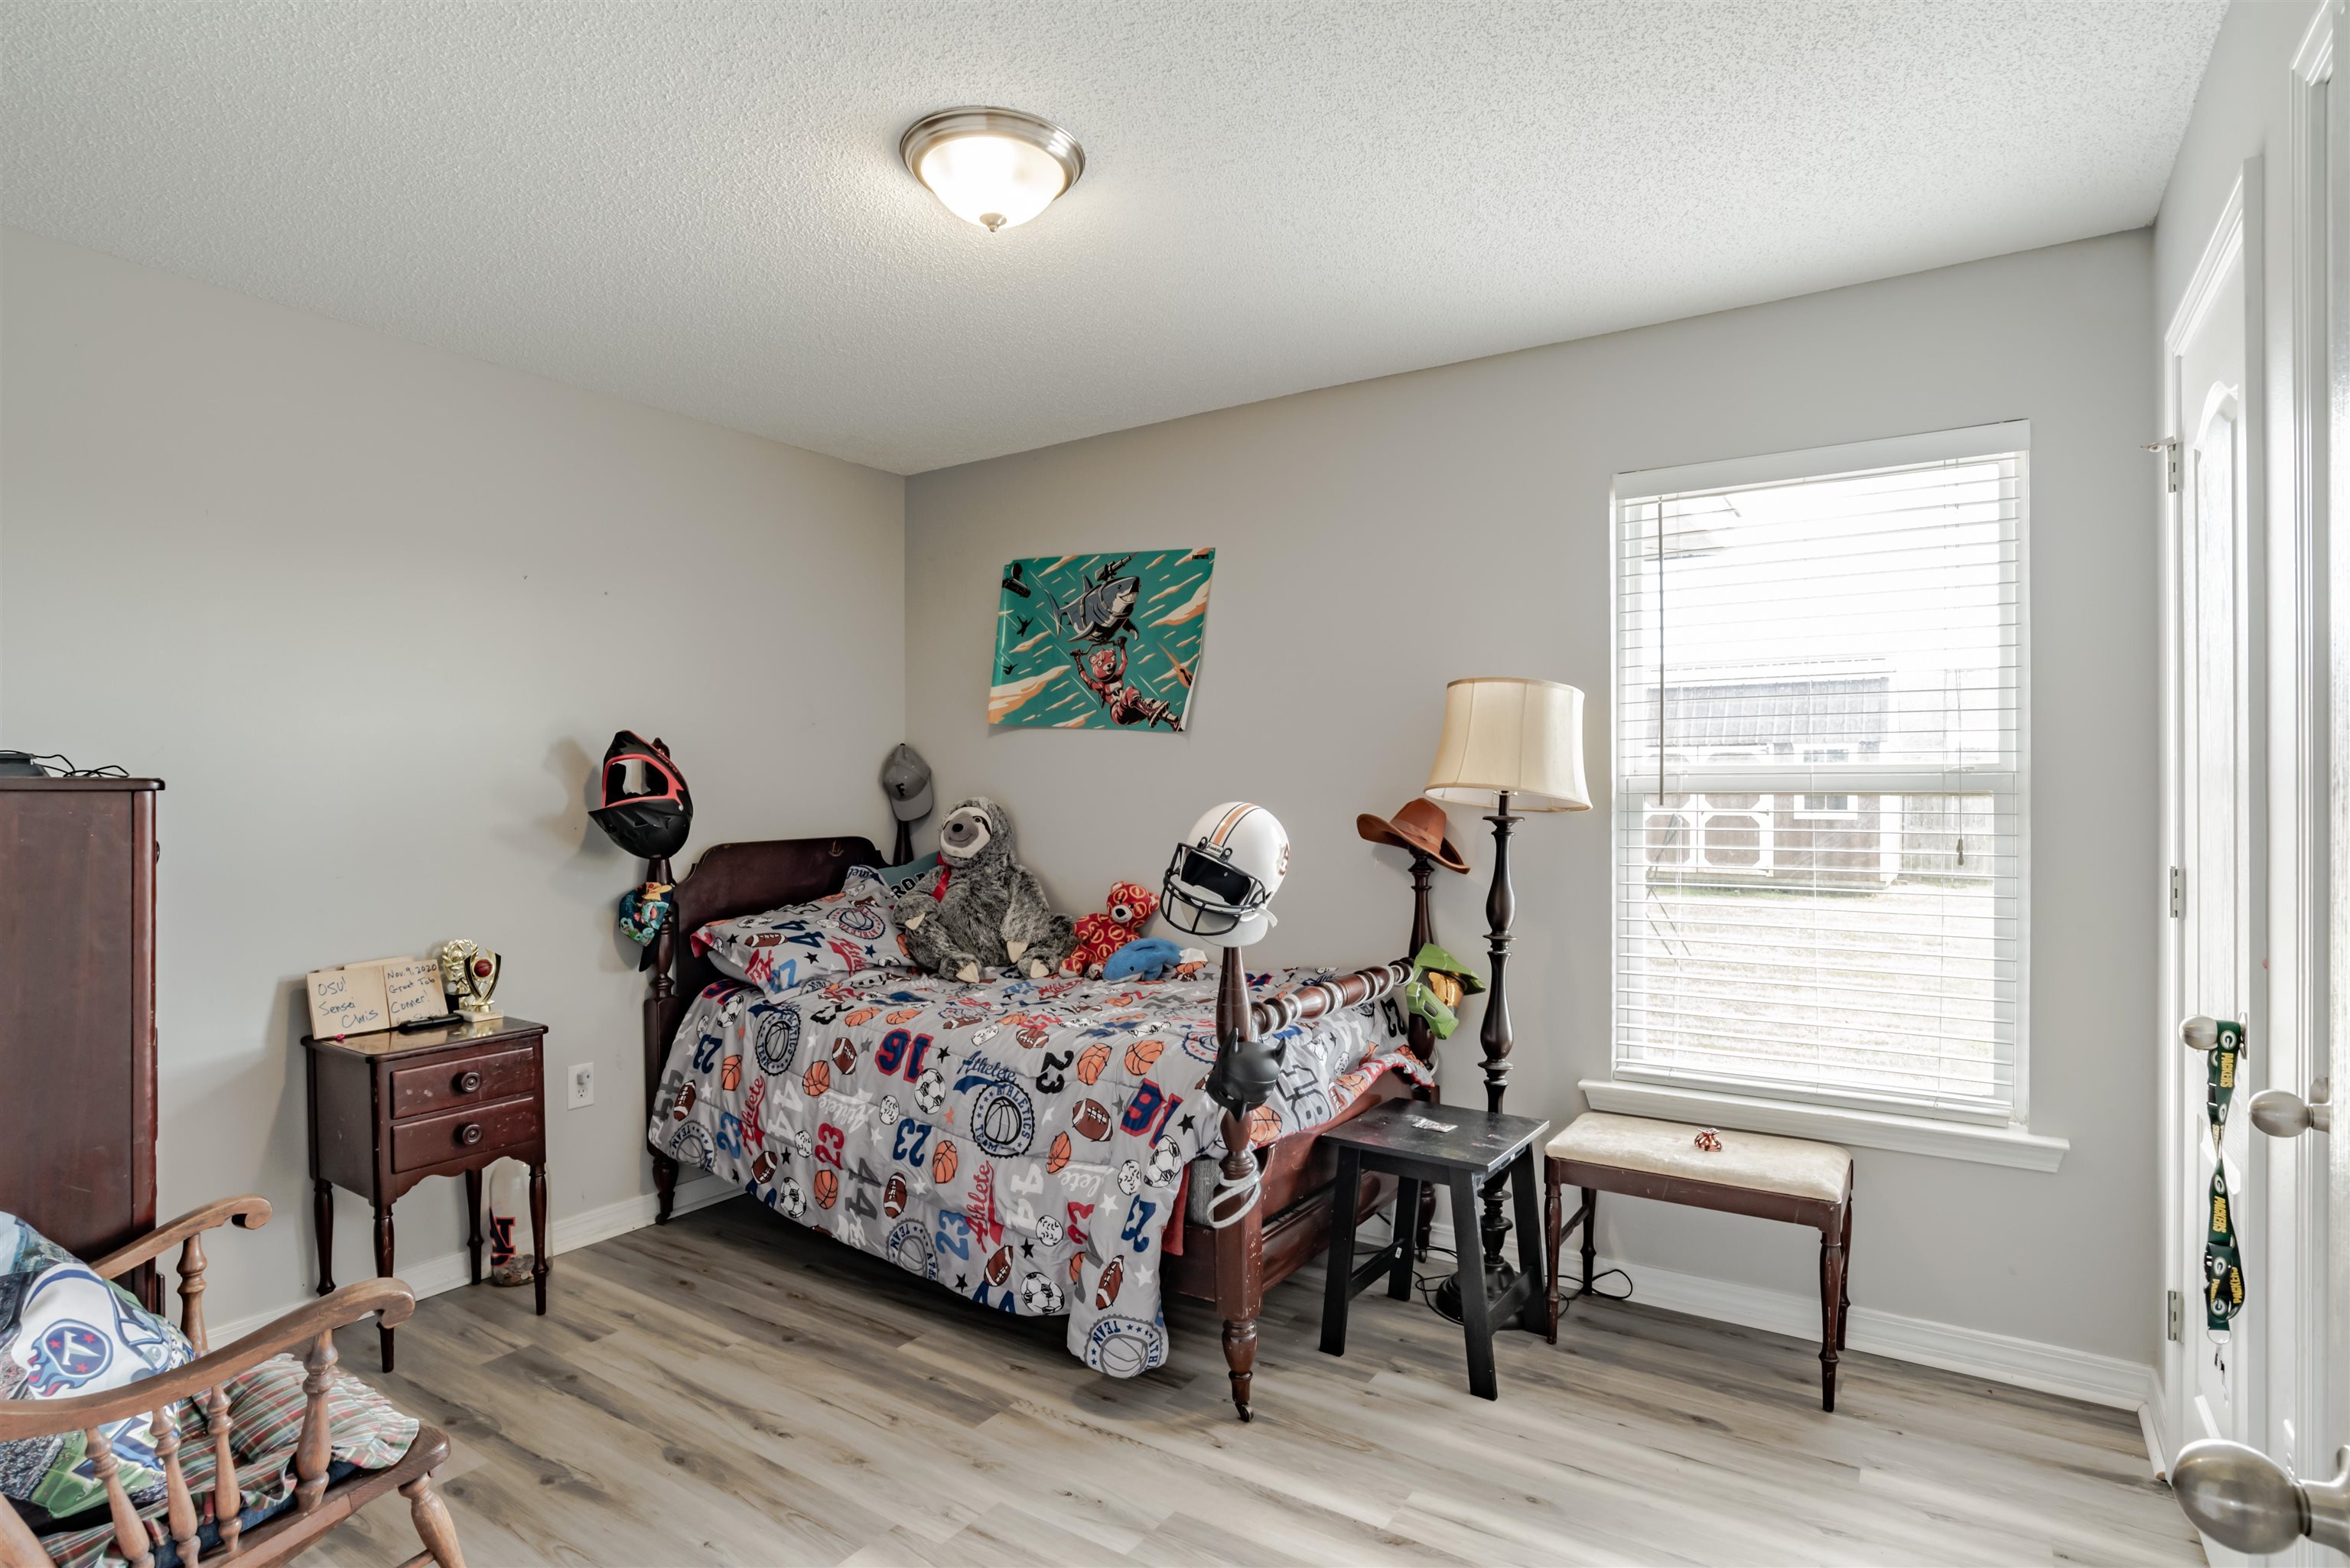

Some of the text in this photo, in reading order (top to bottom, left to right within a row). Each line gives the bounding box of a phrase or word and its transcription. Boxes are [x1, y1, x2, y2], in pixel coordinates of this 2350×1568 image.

[415, 964, 438, 974] 2020
[389, 981, 414, 994] Great
[318, 997, 356, 1016] Sensei
[341, 1010, 379, 1029] Chris
[2220, 1052, 2234, 1088] PACKERS
[975, 1124, 998, 1152] TEAM
[965, 1160, 992, 1254] Athlete
[2212, 1196, 2228, 1233] PACKERS
